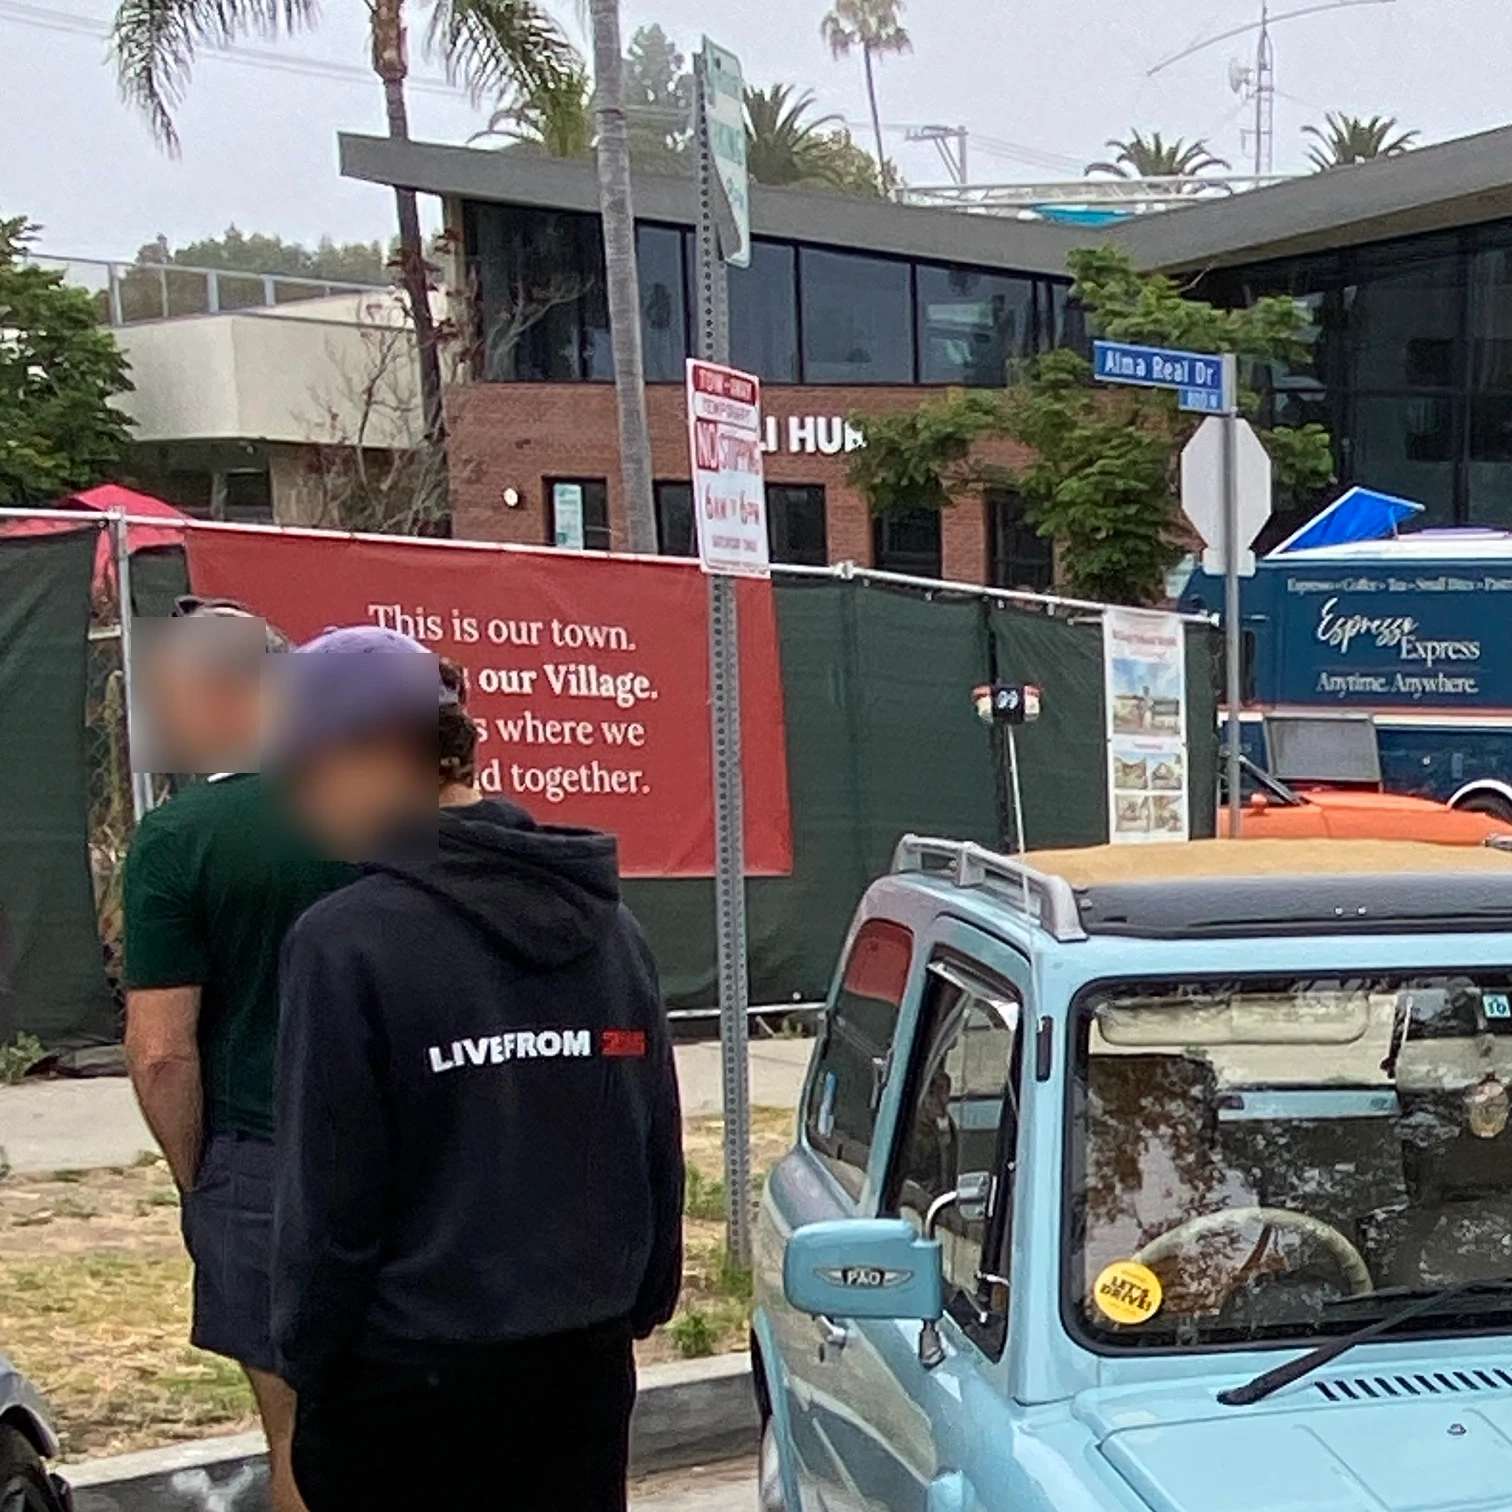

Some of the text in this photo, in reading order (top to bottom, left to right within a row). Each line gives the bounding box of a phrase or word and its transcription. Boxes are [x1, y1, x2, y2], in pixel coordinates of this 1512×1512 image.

[1104, 350, 1214, 386] Alma Real Dr
[697, 422, 718, 469] NO
[368, 603, 637, 651] This is our town.
[1400, 636, 1481, 668] Express
[478, 667, 538, 695] our
[544, 663, 659, 708] Village.
[496, 711, 595, 745] where
[601, 721, 646, 747] we
[512, 760, 651, 803] together.
[847, 1268, 881, 1286] PAO
